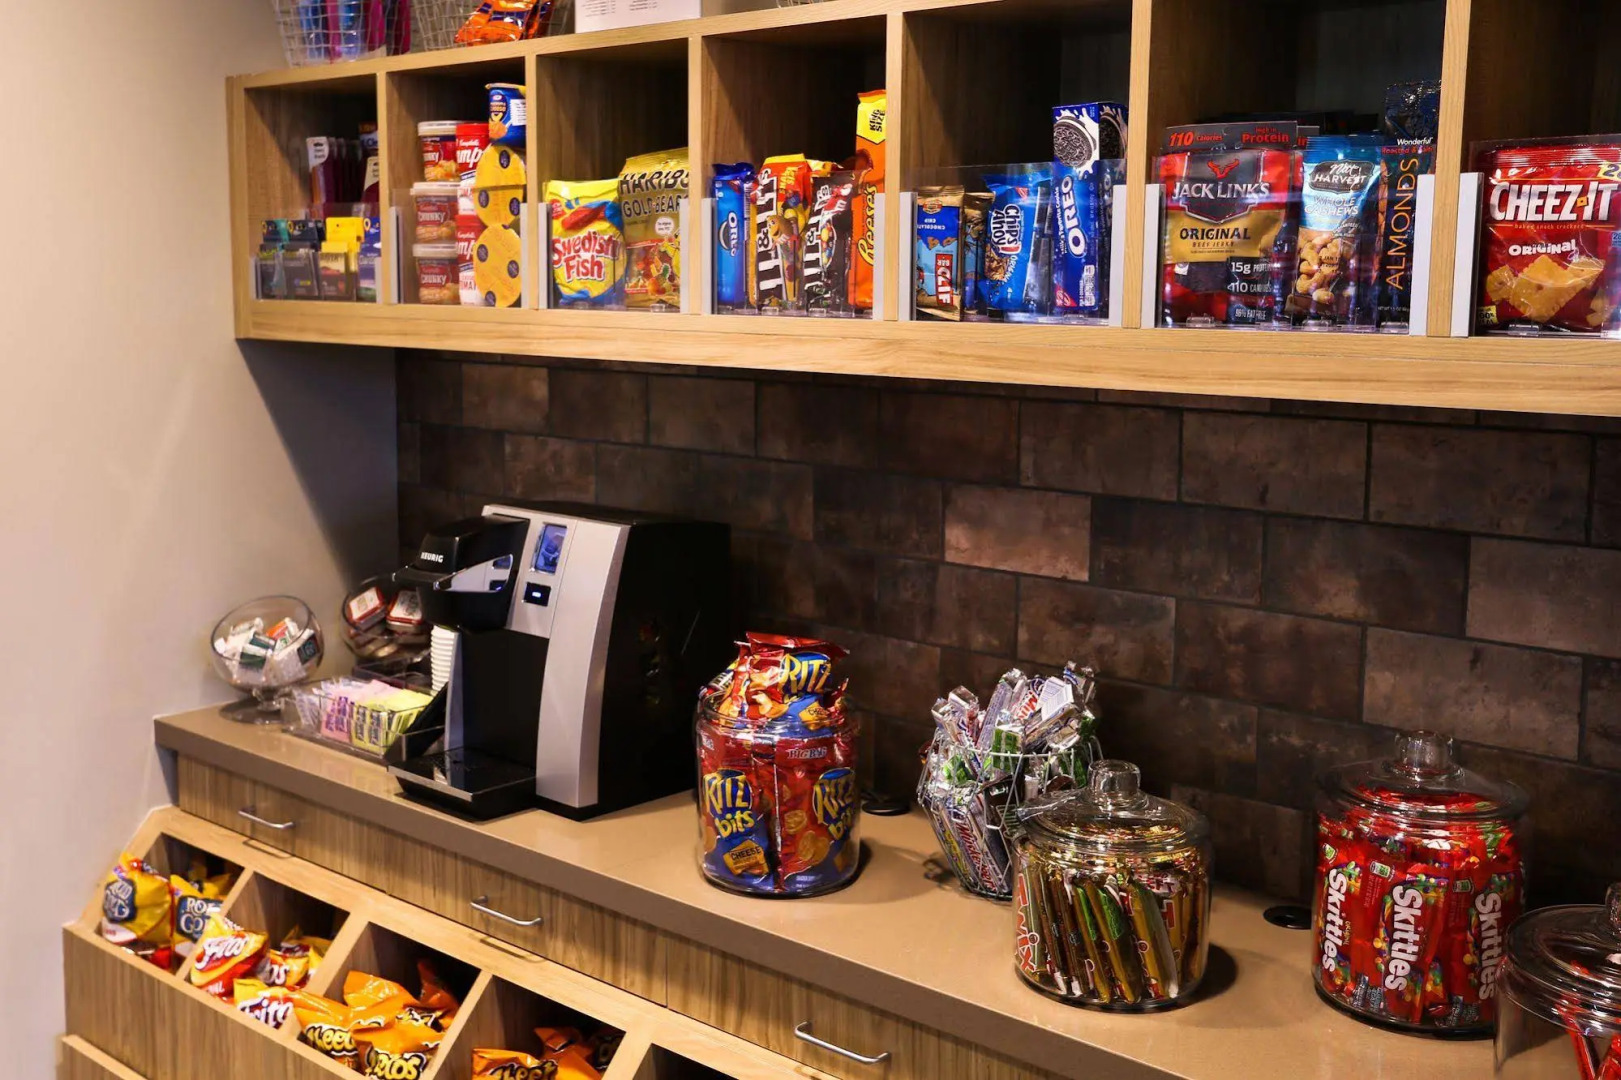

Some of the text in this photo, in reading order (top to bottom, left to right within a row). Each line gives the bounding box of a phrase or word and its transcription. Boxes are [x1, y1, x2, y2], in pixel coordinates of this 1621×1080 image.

[1169, 131, 1194, 147] 110
[1241, 132, 1290, 144] Protein
[1397, 137, 1433, 146] Wonderful
[1172, 181, 1216, 200] JACK
[1004, 204, 1021, 245] Chips
[1061, 175, 1086, 256] OREO
[1304, 204, 1359, 216] CASHEWS
[1385, 158, 1419, 291] ALMONDS
[551, 230, 619, 266] Swedish
[1179, 227, 1251, 241] ORIGINAL
[564, 253, 604, 281] Fish
[1231, 261, 1251, 274] 15g
[936, 267, 952, 304] CLIF
[779, 653, 831, 694] RITZ
[703, 773, 749, 814] RITZ
[714, 810, 755, 838] bits
[731, 847, 761, 860] CHEESE
[1322, 868, 1347, 973] Skittles
[1385, 885, 1423, 991] Skittles
[1474, 892, 1502, 1000] Skittles
